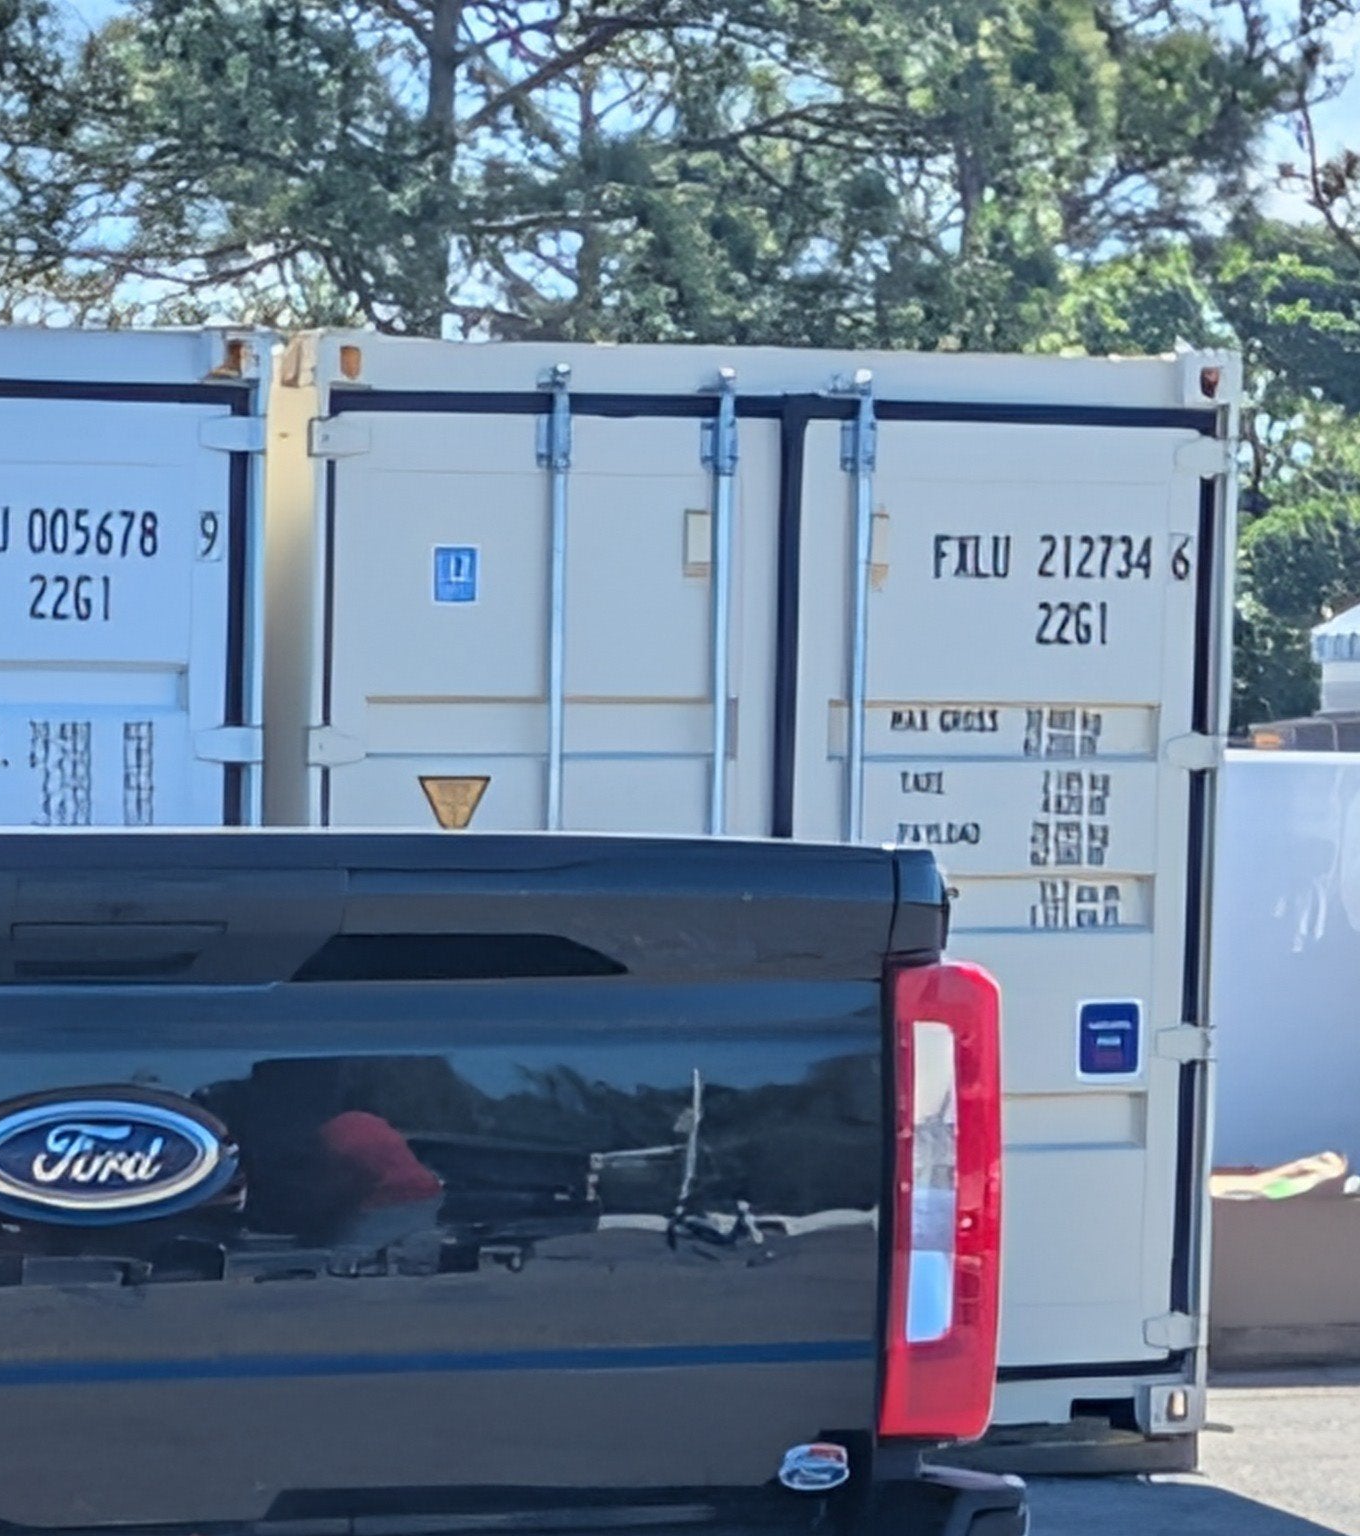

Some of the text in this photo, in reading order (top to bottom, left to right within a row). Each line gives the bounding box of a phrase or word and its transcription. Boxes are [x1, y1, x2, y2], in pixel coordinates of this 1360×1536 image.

[27, 507, 158, 557] 005678
[199, 510, 219, 557] 9
[933, 534, 1191, 581] FXLU 212734 6
[29, 573, 111, 622] 22G1
[1035, 601, 1108, 645] 22G1
[32, 1122, 163, 1182] Ford
